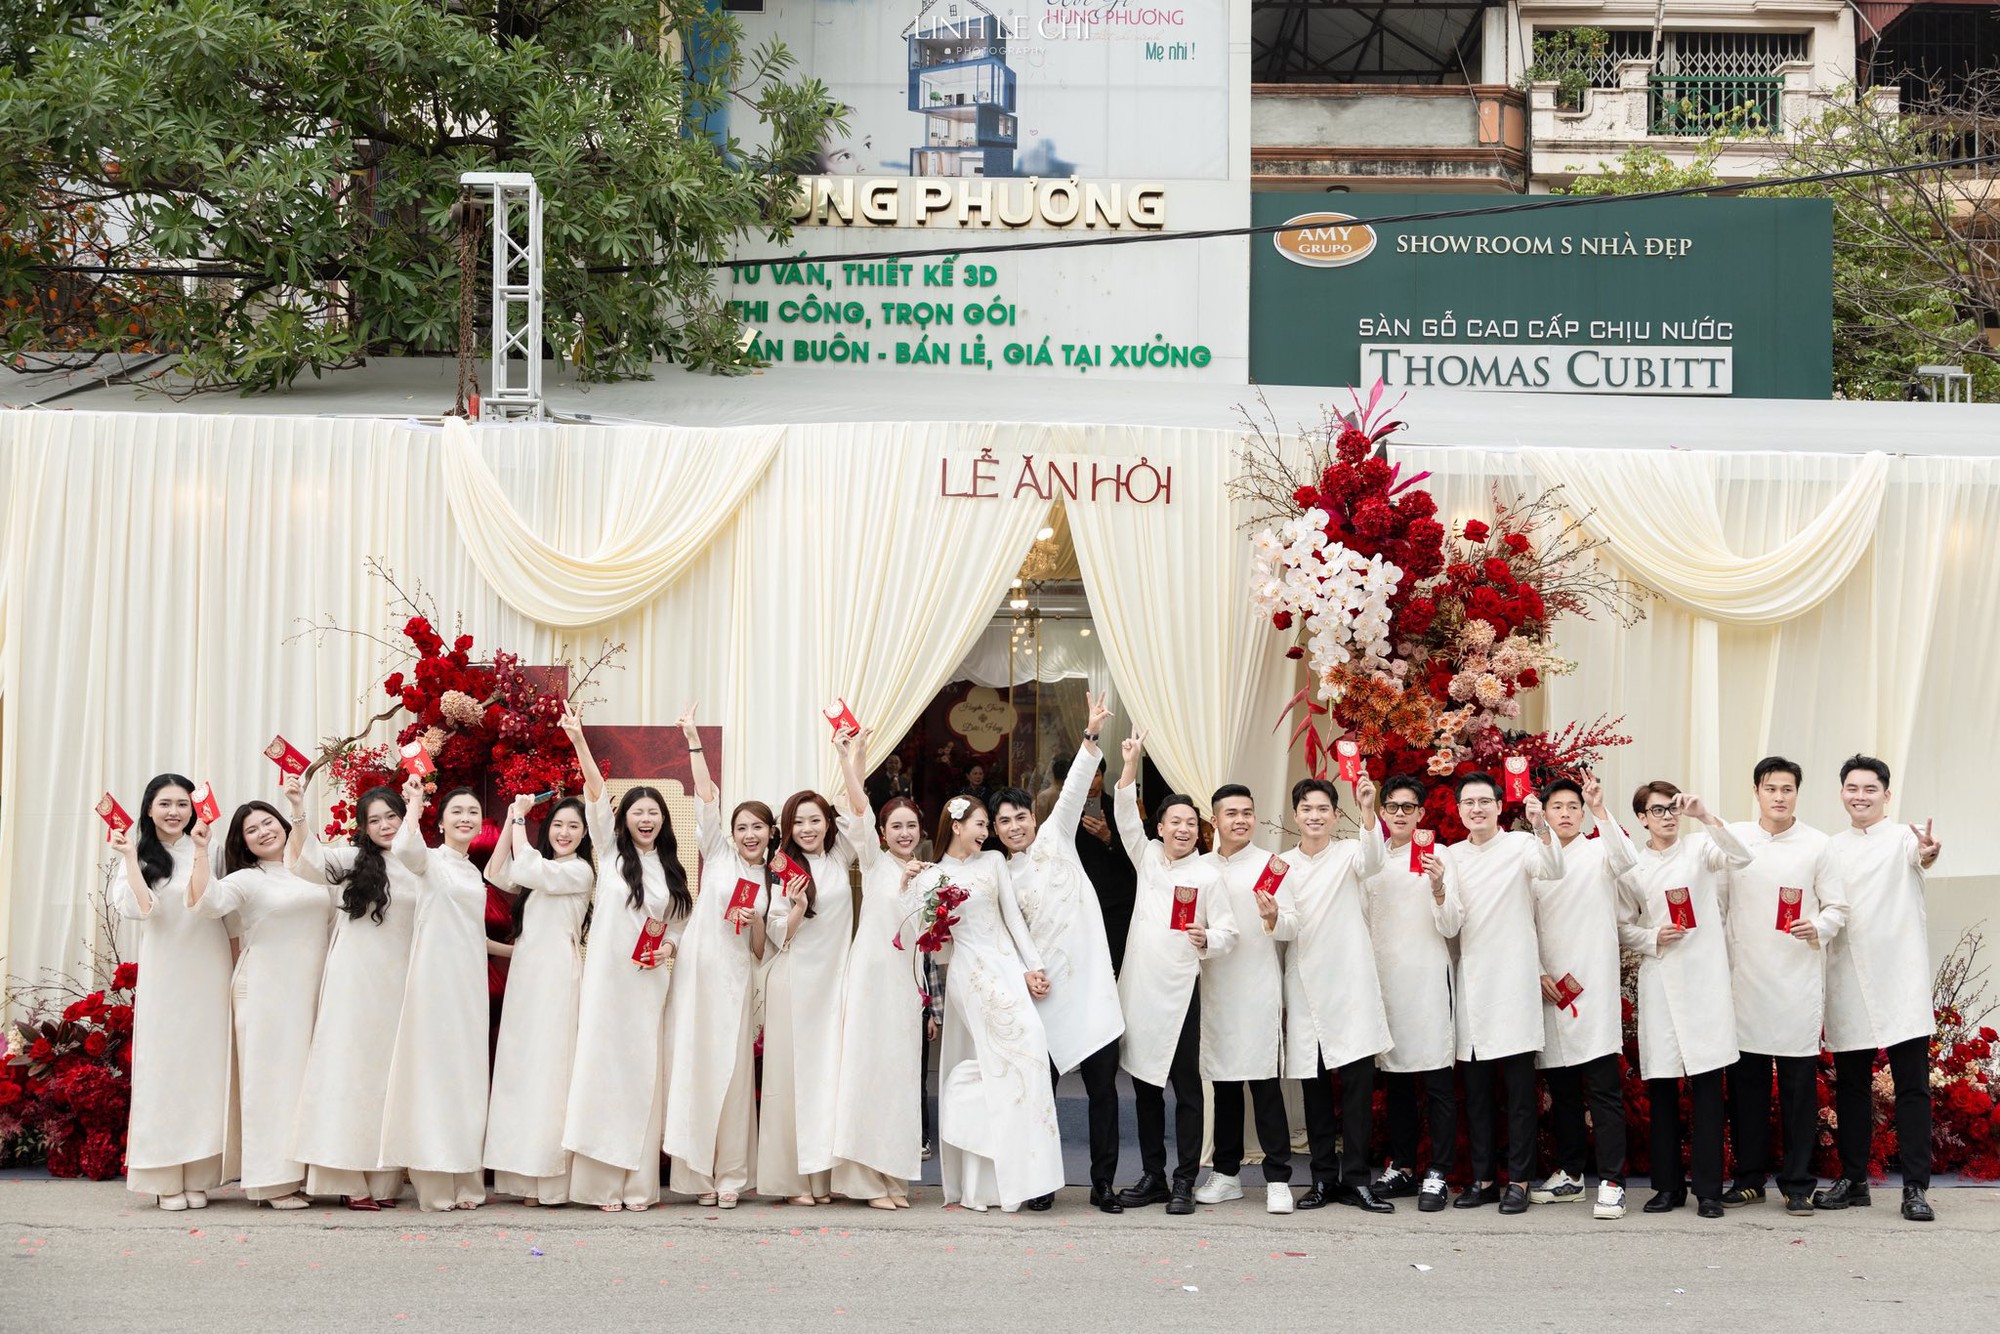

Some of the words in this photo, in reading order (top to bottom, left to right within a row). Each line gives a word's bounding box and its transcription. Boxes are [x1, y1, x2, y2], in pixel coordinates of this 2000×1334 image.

[1105, 8, 1184, 26] PHƯƠNG
[1145, 42, 1164, 62] Mẹ
[764, 175, 899, 225] UNG
[915, 174, 1166, 230] PHƯƠNG
[1297, 226, 1353, 242] AMY
[1298, 243, 1352, 254] GRUPO
[1396, 234, 1555, 255] SHOWROOM
[1560, 236, 1573, 255] S
[1580, 231, 1639, 256] NHÀ
[1644, 237, 1693, 260] ĐẸP
[923, 253, 960, 287] KẾ
[963, 264, 998, 287] 3D
[778, 293, 872, 329] CÔNG,
[881, 302, 954, 330] TRỌN
[963, 294, 1016, 326] GÓI
[1358, 312, 1411, 337] SÀN
[1422, 310, 1457, 338] GỖ
[1466, 319, 1519, 338] CAO
[1528, 312, 1580, 339] CẤP
[1590, 320, 1650, 343] CHỊU
[1661, 315, 1734, 340] NƯỚC
[741, 330, 784, 362] ÁN
[793, 332, 869, 363] BUÔN
[895, 333, 950, 364] BÁN
[960, 333, 993, 370] LẺ,
[1002, 335, 1054, 366] GIÁ
[1061, 344, 1101, 372] TẠI
[1109, 333, 1212, 368] XƯỞNG
[1368, 348, 1551, 388] THOMAS
[1566, 349, 1727, 389] CUBITT
[941, 448, 1000, 499] LỄ
[1012, 454, 1078, 501] ĂN
[1091, 456, 1172, 505] HỎI
